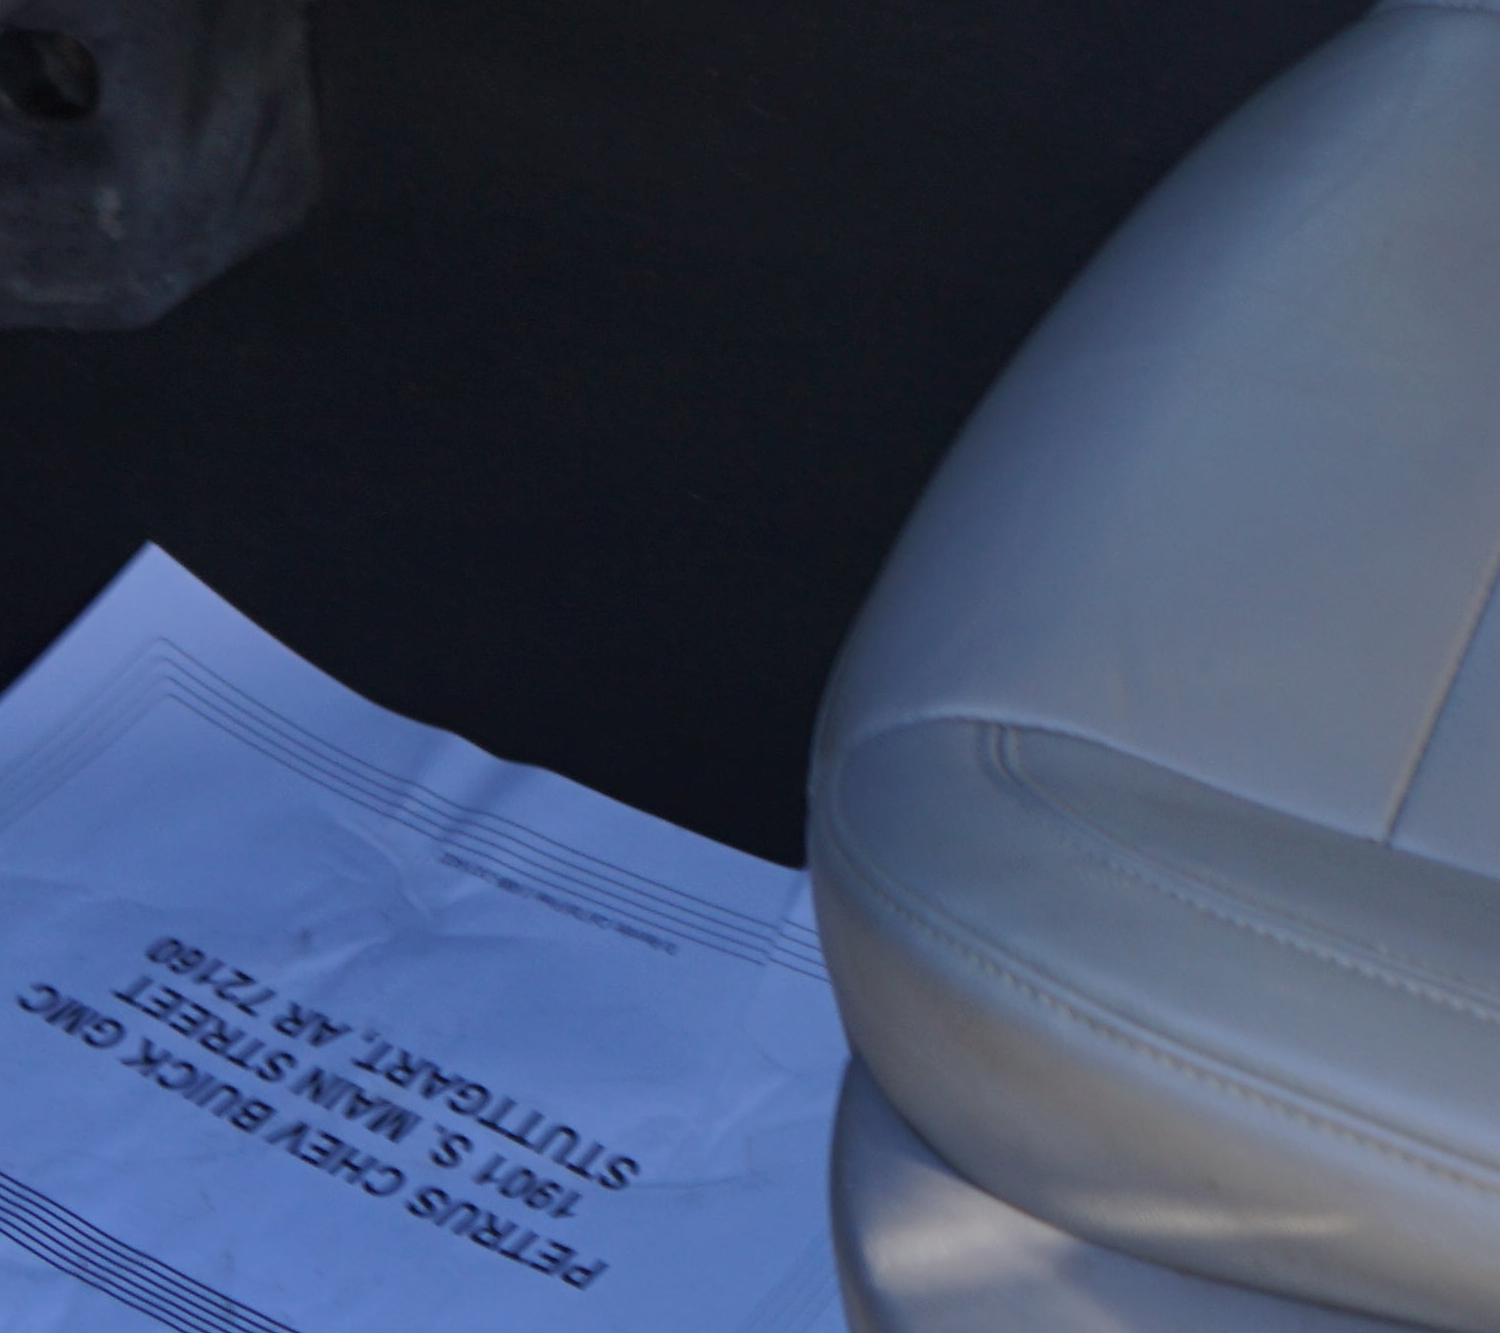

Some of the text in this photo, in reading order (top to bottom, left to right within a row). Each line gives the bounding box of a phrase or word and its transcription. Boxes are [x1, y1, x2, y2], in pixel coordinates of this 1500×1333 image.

[14, 981, 610, 1292] PETRUS CHEV BUICK GMC
[108, 973, 584, 1222] 1901 S. MAIN STREET
[145, 936, 643, 1193] STUTTGART, AR 72160
